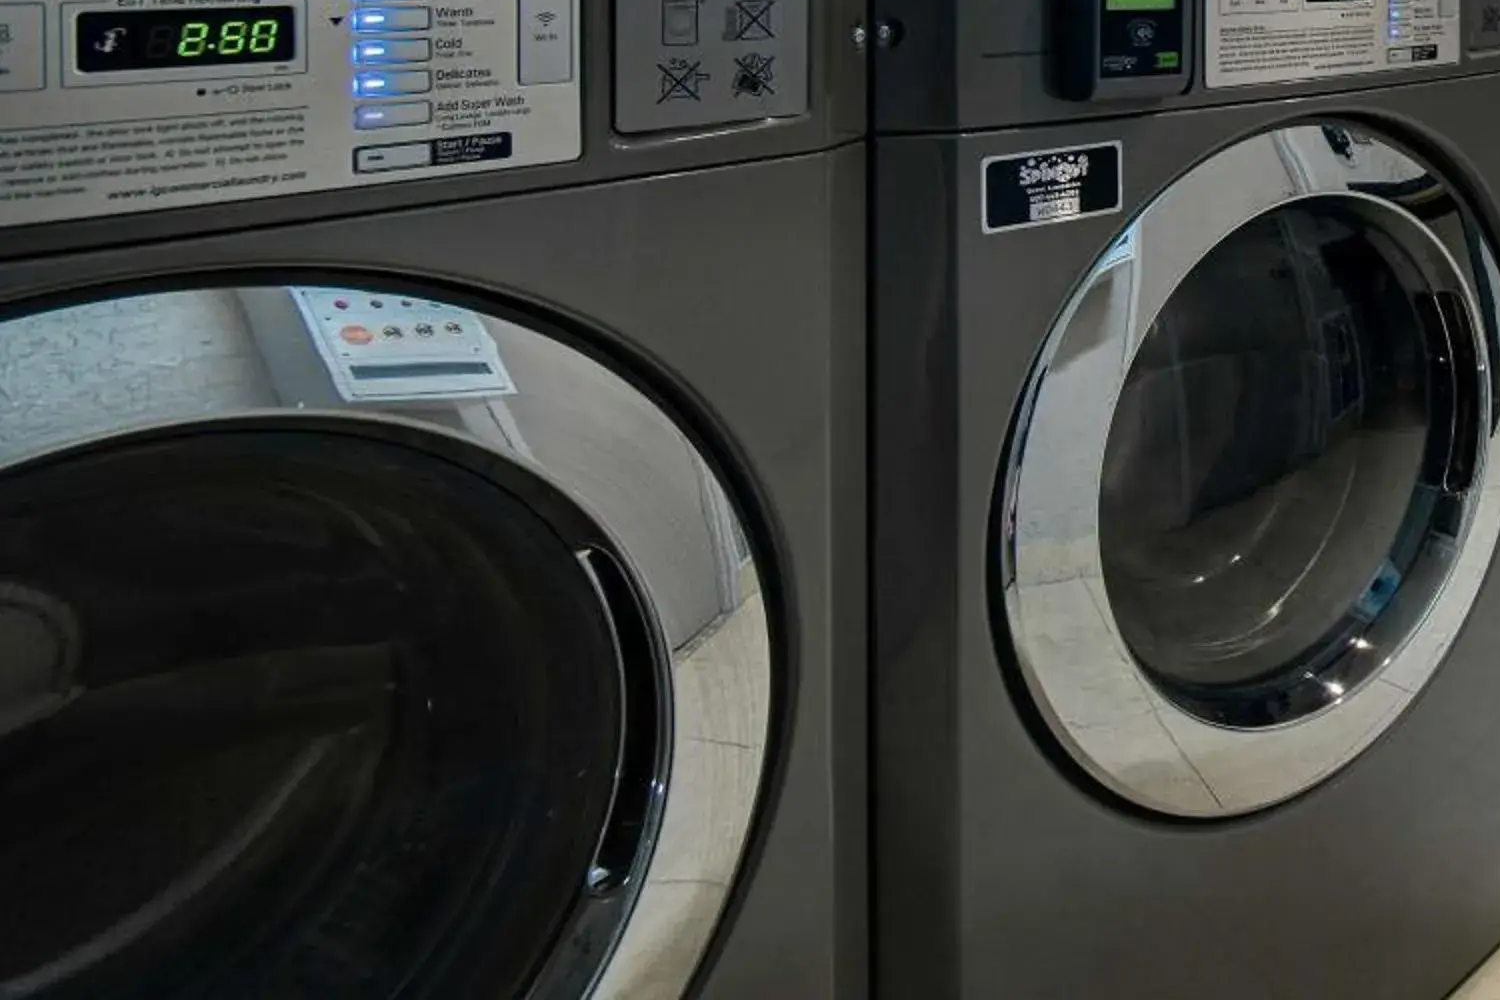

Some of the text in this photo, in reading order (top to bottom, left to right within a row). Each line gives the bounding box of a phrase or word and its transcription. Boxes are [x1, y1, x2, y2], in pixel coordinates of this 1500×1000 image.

[435, 7, 473, 17] Warm
[435, 38, 462, 48] Cold
[436, 69, 491, 80] Delicates
[437, 96, 525, 111] Add Super Wash
